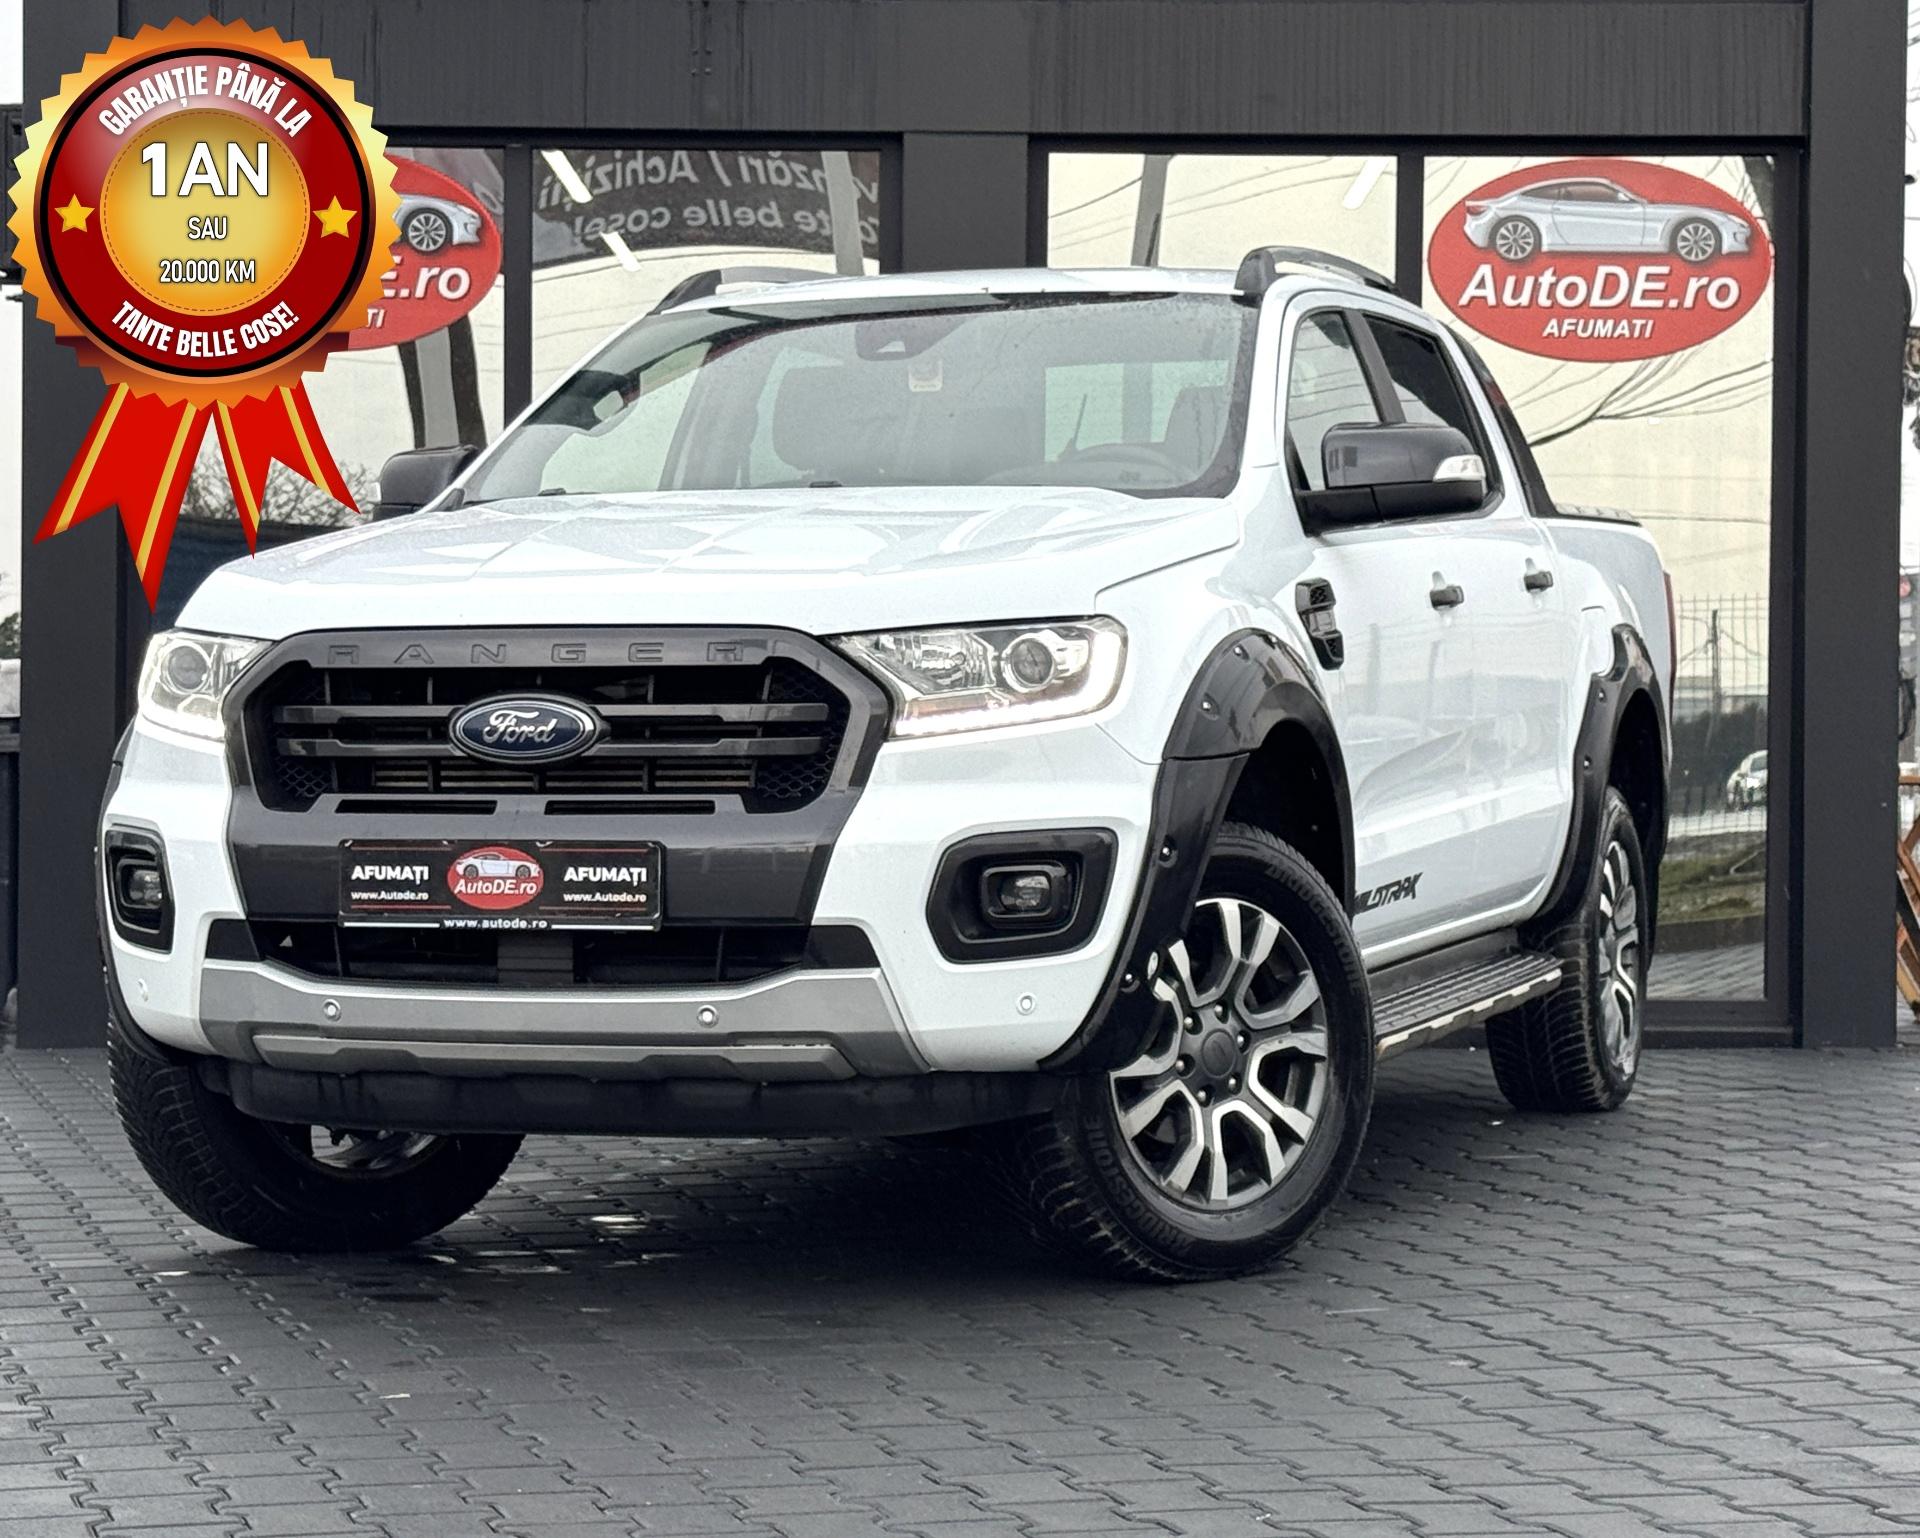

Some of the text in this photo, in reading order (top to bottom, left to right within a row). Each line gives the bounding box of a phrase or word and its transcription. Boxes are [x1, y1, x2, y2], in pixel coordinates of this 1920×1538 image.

[1459, 264, 1741, 310] AutoDE.ro
[1542, 318, 1655, 340] AFUMATI
[328, 641, 744, 665] RANGER
[482, 709, 558, 744] Ford
[351, 865, 429, 885] AFUMAȚI
[563, 866, 647, 887] AFUMAȚI
[351, 890, 429, 901] www.Autode.ro
[454, 878, 537, 896] AutoDE.ro
[563, 892, 647, 903] www.Autode.ro
[443, 918, 548, 930] www.autode.ro
